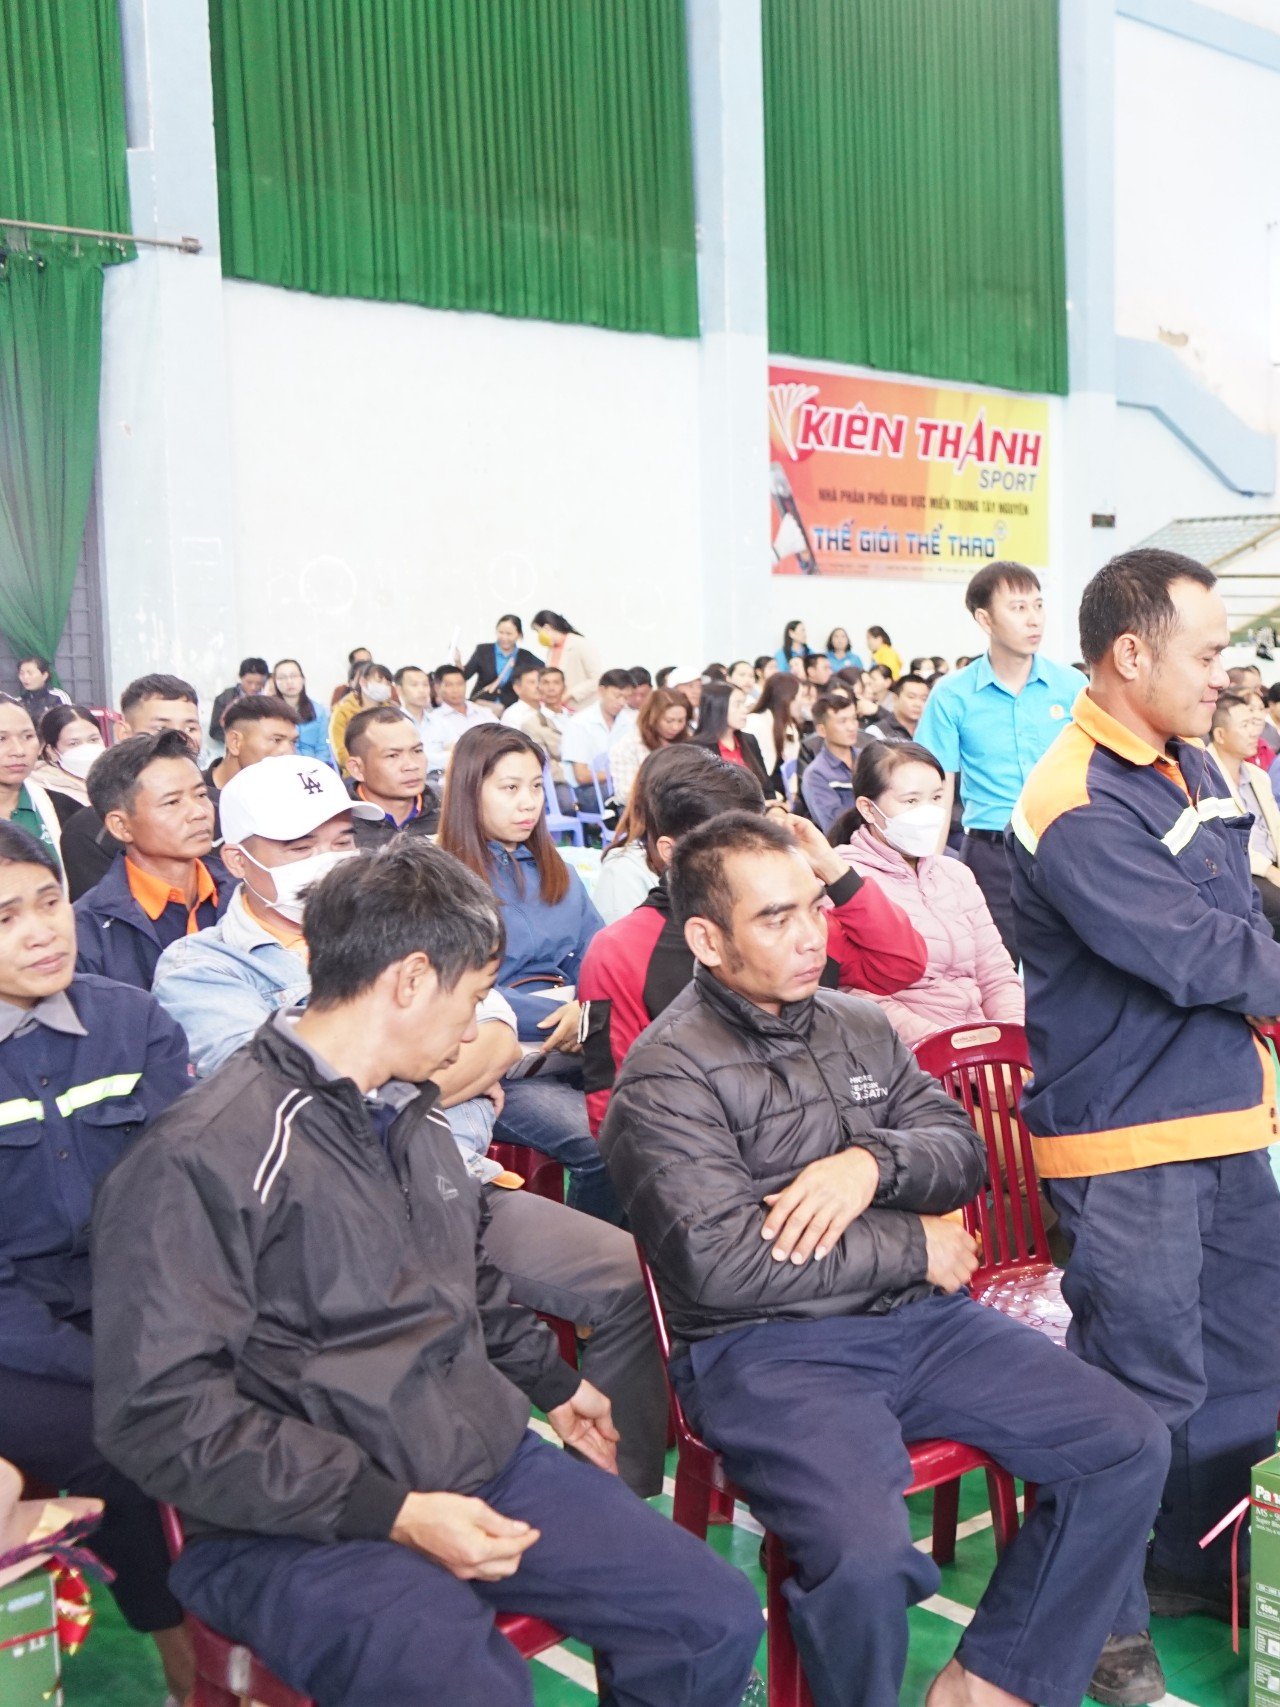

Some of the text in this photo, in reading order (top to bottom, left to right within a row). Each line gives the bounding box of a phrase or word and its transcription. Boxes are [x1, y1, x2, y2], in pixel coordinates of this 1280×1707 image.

[979, 469, 1037, 491] SPORT
[948, 535, 995, 558] THAO
[297, 772, 323, 795] LA
